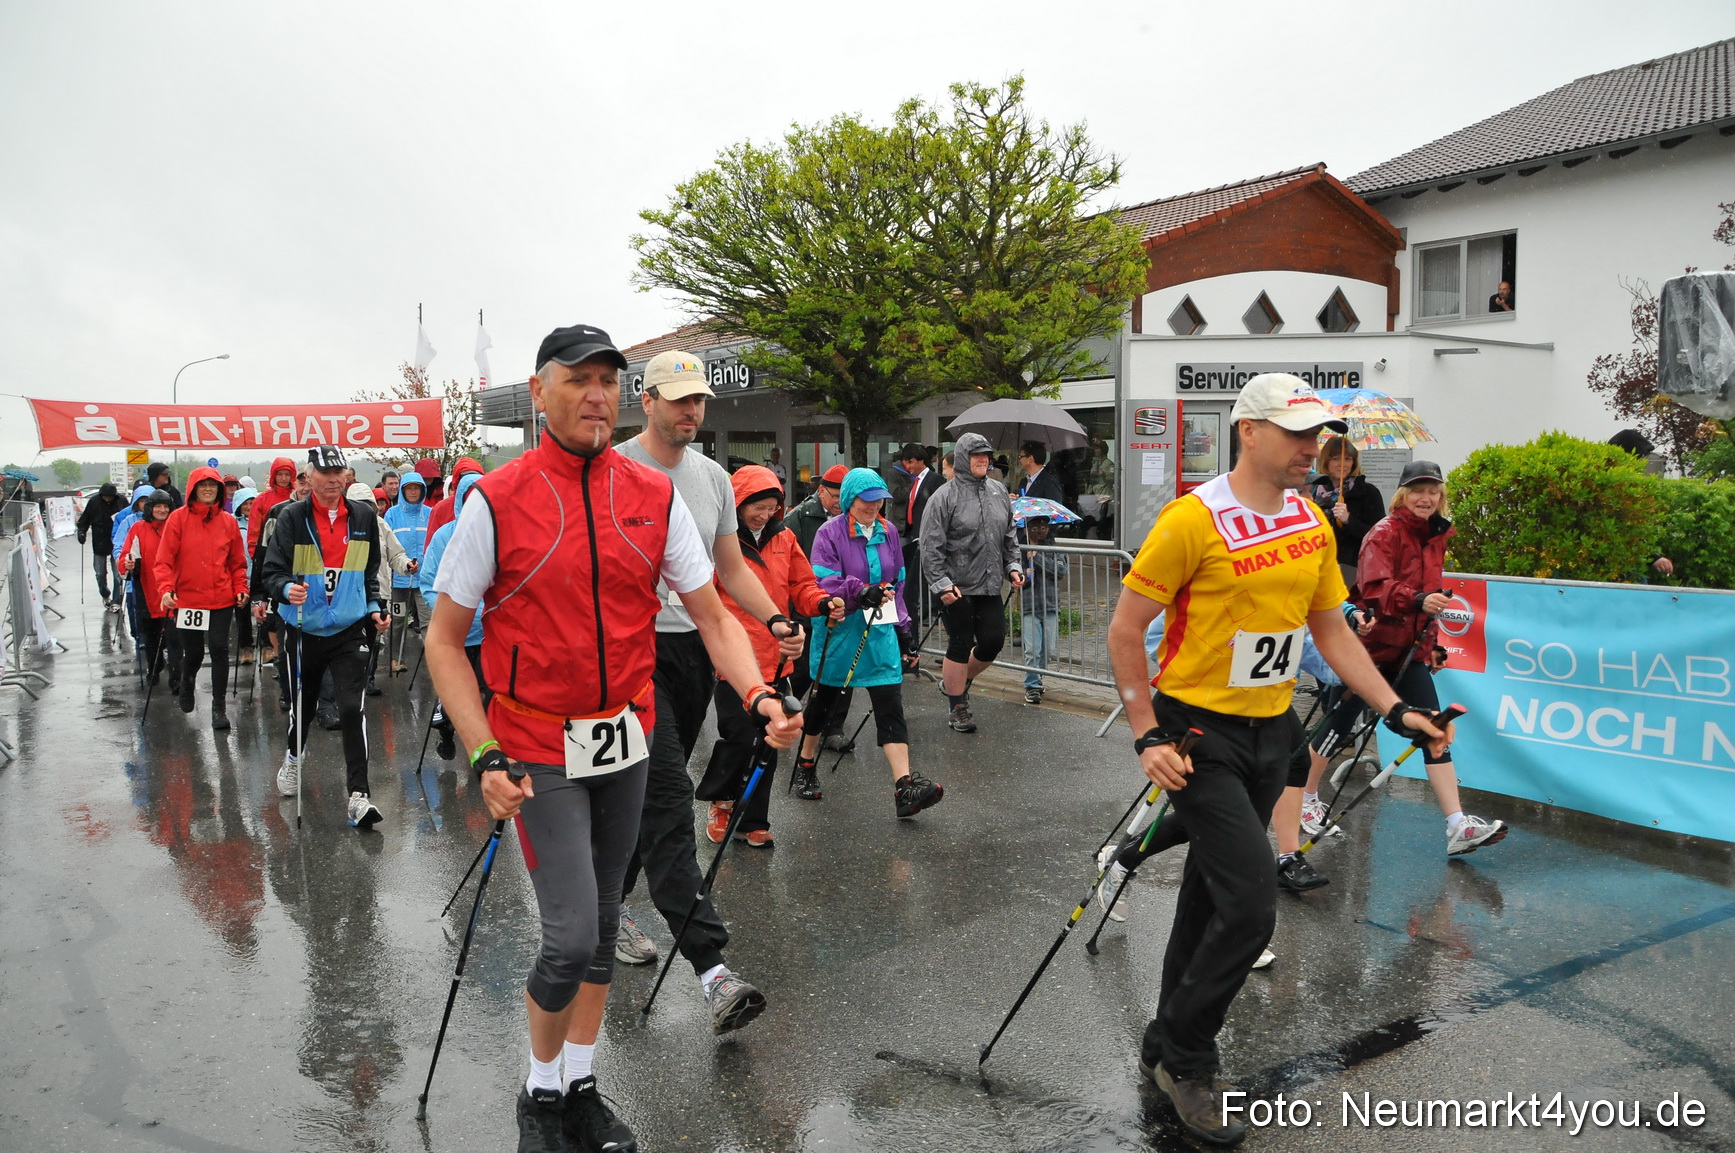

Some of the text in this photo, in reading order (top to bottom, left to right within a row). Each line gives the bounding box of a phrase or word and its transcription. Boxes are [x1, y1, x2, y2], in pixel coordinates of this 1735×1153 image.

[325, 569, 342, 592] 3
[1232, 549, 1284, 577] MAX
[184, 610, 203, 627] 38
[1250, 633, 1293, 679] 24
[1504, 638, 1732, 697] SO HAB
[591, 715, 629, 767] 21
[1496, 694, 1677, 756] NOCH
